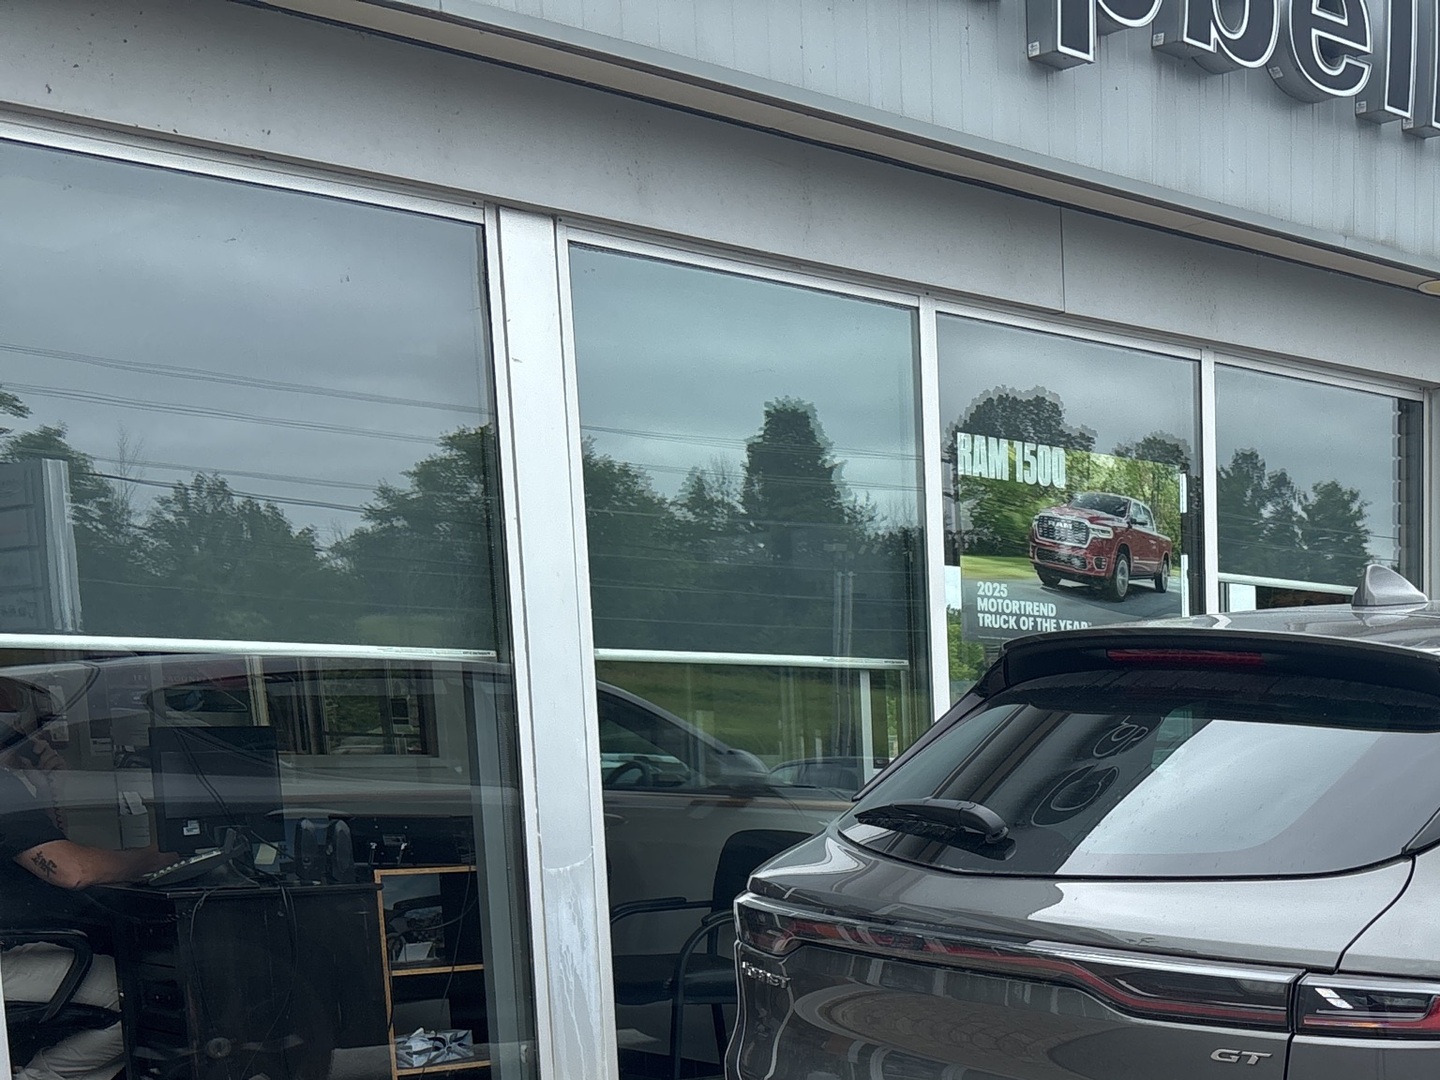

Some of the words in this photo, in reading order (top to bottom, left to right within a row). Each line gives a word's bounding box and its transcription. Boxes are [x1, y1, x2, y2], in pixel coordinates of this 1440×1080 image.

[956, 432, 1009, 481] RAM
[1014, 440, 1067, 489] 1500
[977, 581, 1008, 597] 2025
[976, 597, 1057, 617] MOTORTREND
[977, 613, 1018, 630] TRUCK
[1019, 616, 1036, 631] OF
[1036, 617, 1057, 632] THE
[1210, 1048, 1273, 1065] GT
